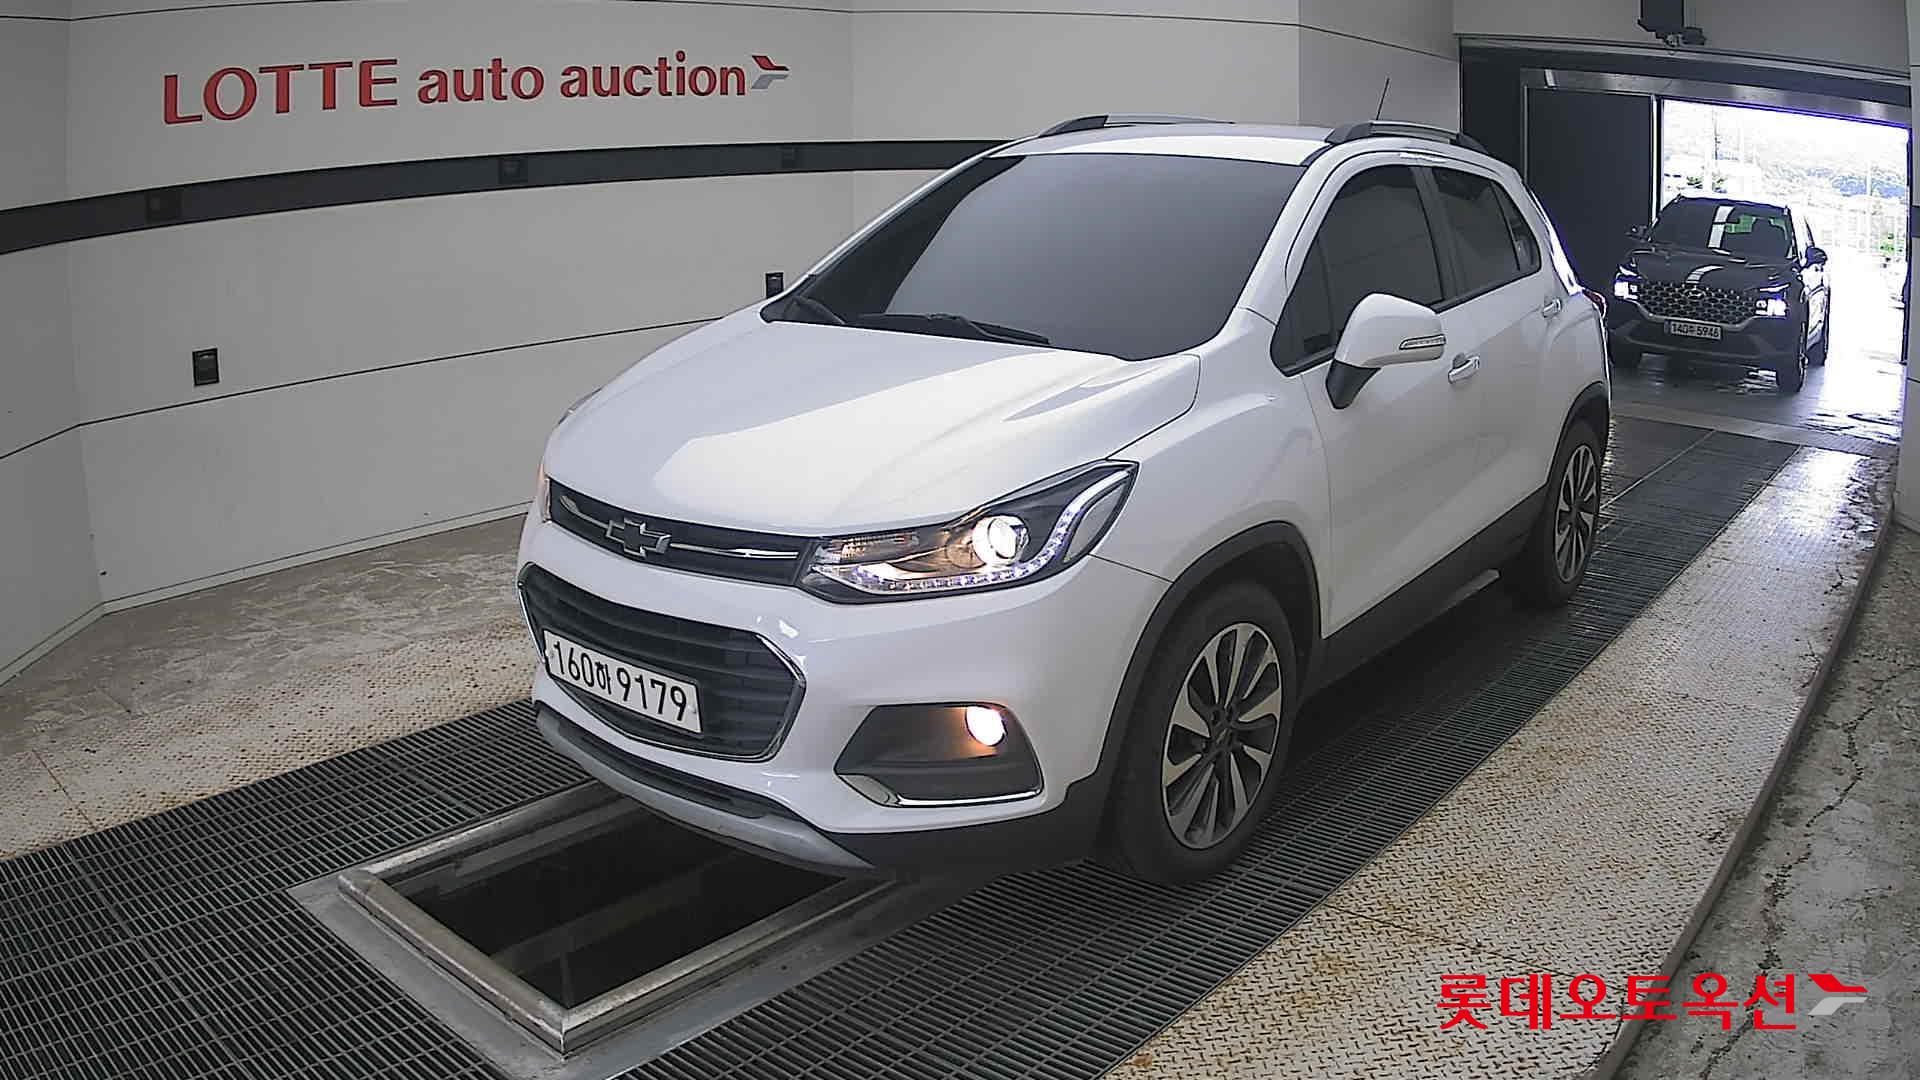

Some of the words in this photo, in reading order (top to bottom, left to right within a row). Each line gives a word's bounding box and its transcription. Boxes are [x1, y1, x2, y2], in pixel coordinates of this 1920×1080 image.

[164, 58, 398, 125] LOTTE
[417, 57, 545, 104] auto
[560, 50, 746, 97] auction
